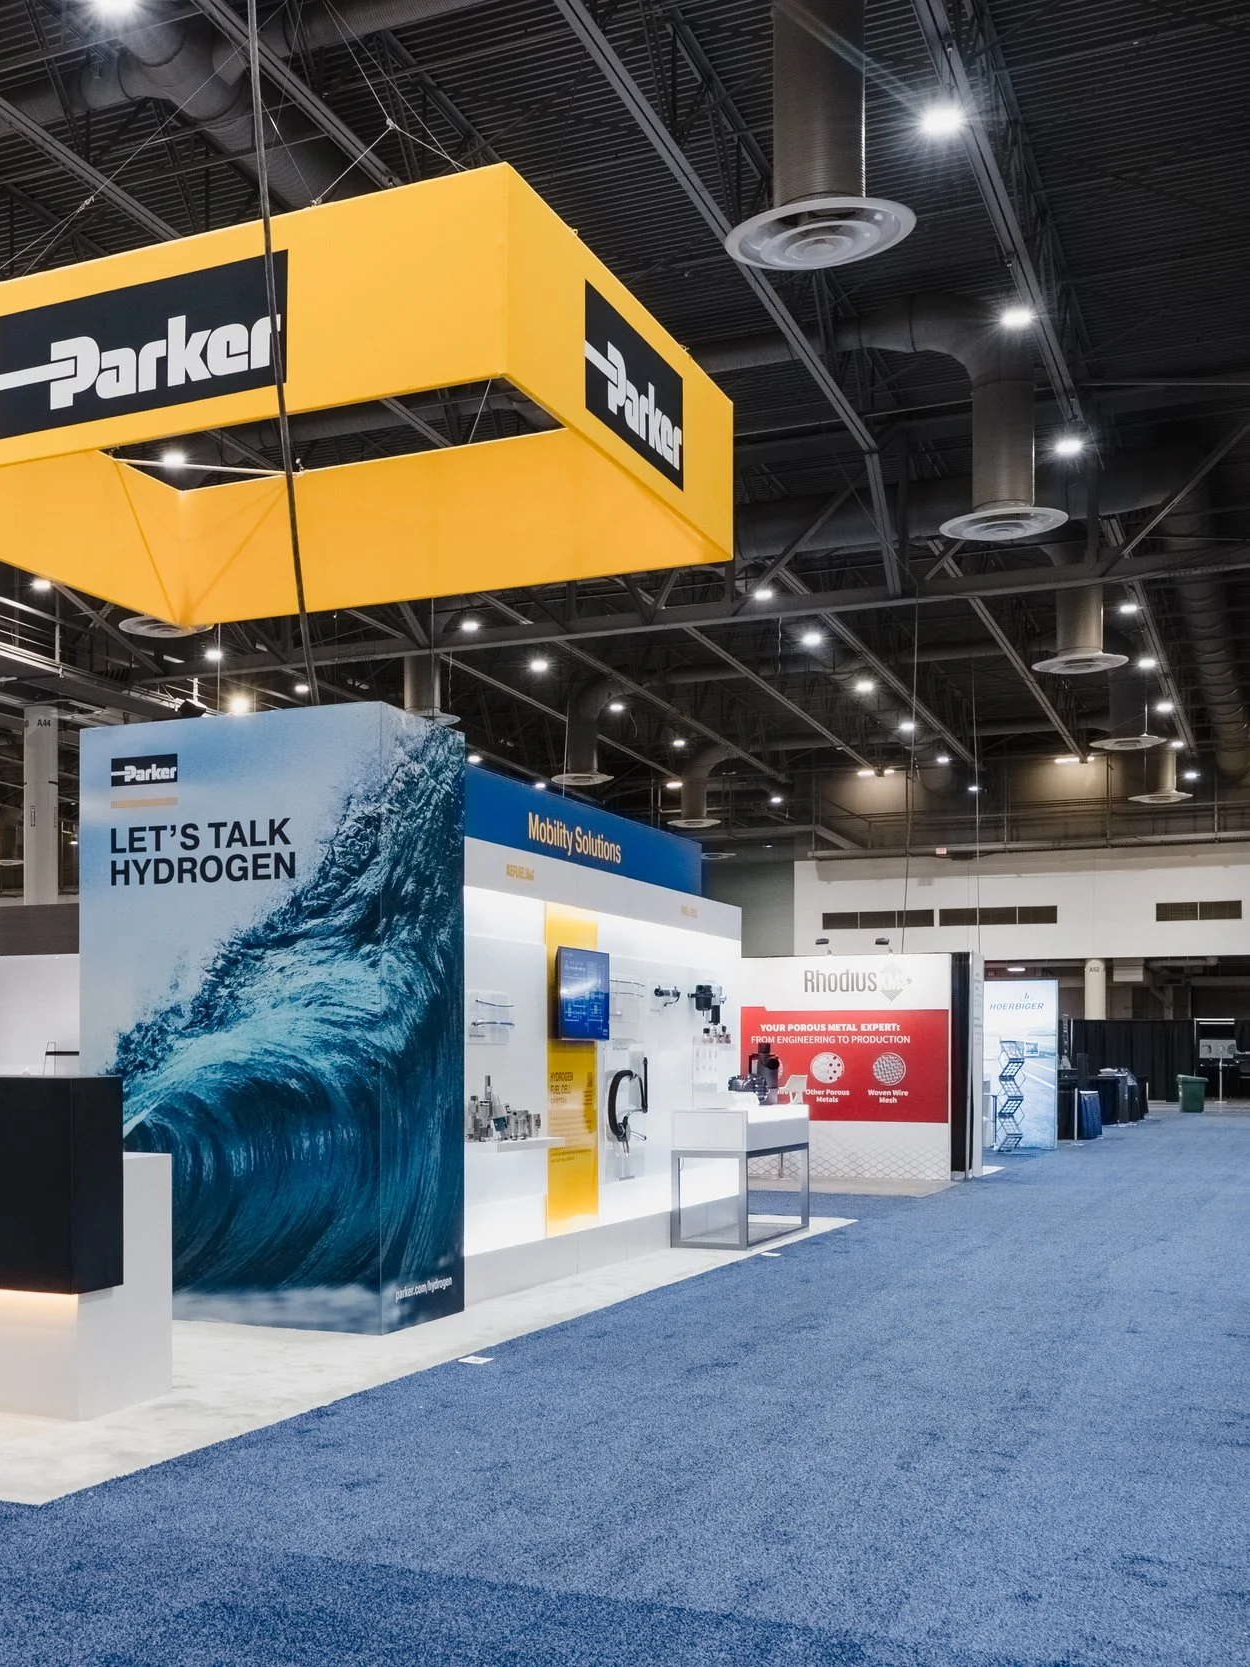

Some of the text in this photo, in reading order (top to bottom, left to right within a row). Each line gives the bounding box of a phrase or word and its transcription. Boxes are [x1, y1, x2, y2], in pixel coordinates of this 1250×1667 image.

[49, 314, 282, 410] Parker
[607, 340, 683, 471] Parker
[124, 764, 177, 782] Parker
[111, 818, 291, 854] LET’S TALK
[528, 812, 621, 864] Mobility Solutions
[111, 852, 296, 886] HYDROGEN
[804, 969, 878, 992] Rhodius
[751, 1035, 910, 1044] FROM ENGINEERING TO PRODUCTION
[760, 1023, 900, 1032] YOUR POROUS METAL EXPERT:
[550, 1072, 574, 1082] HYDROGEN
